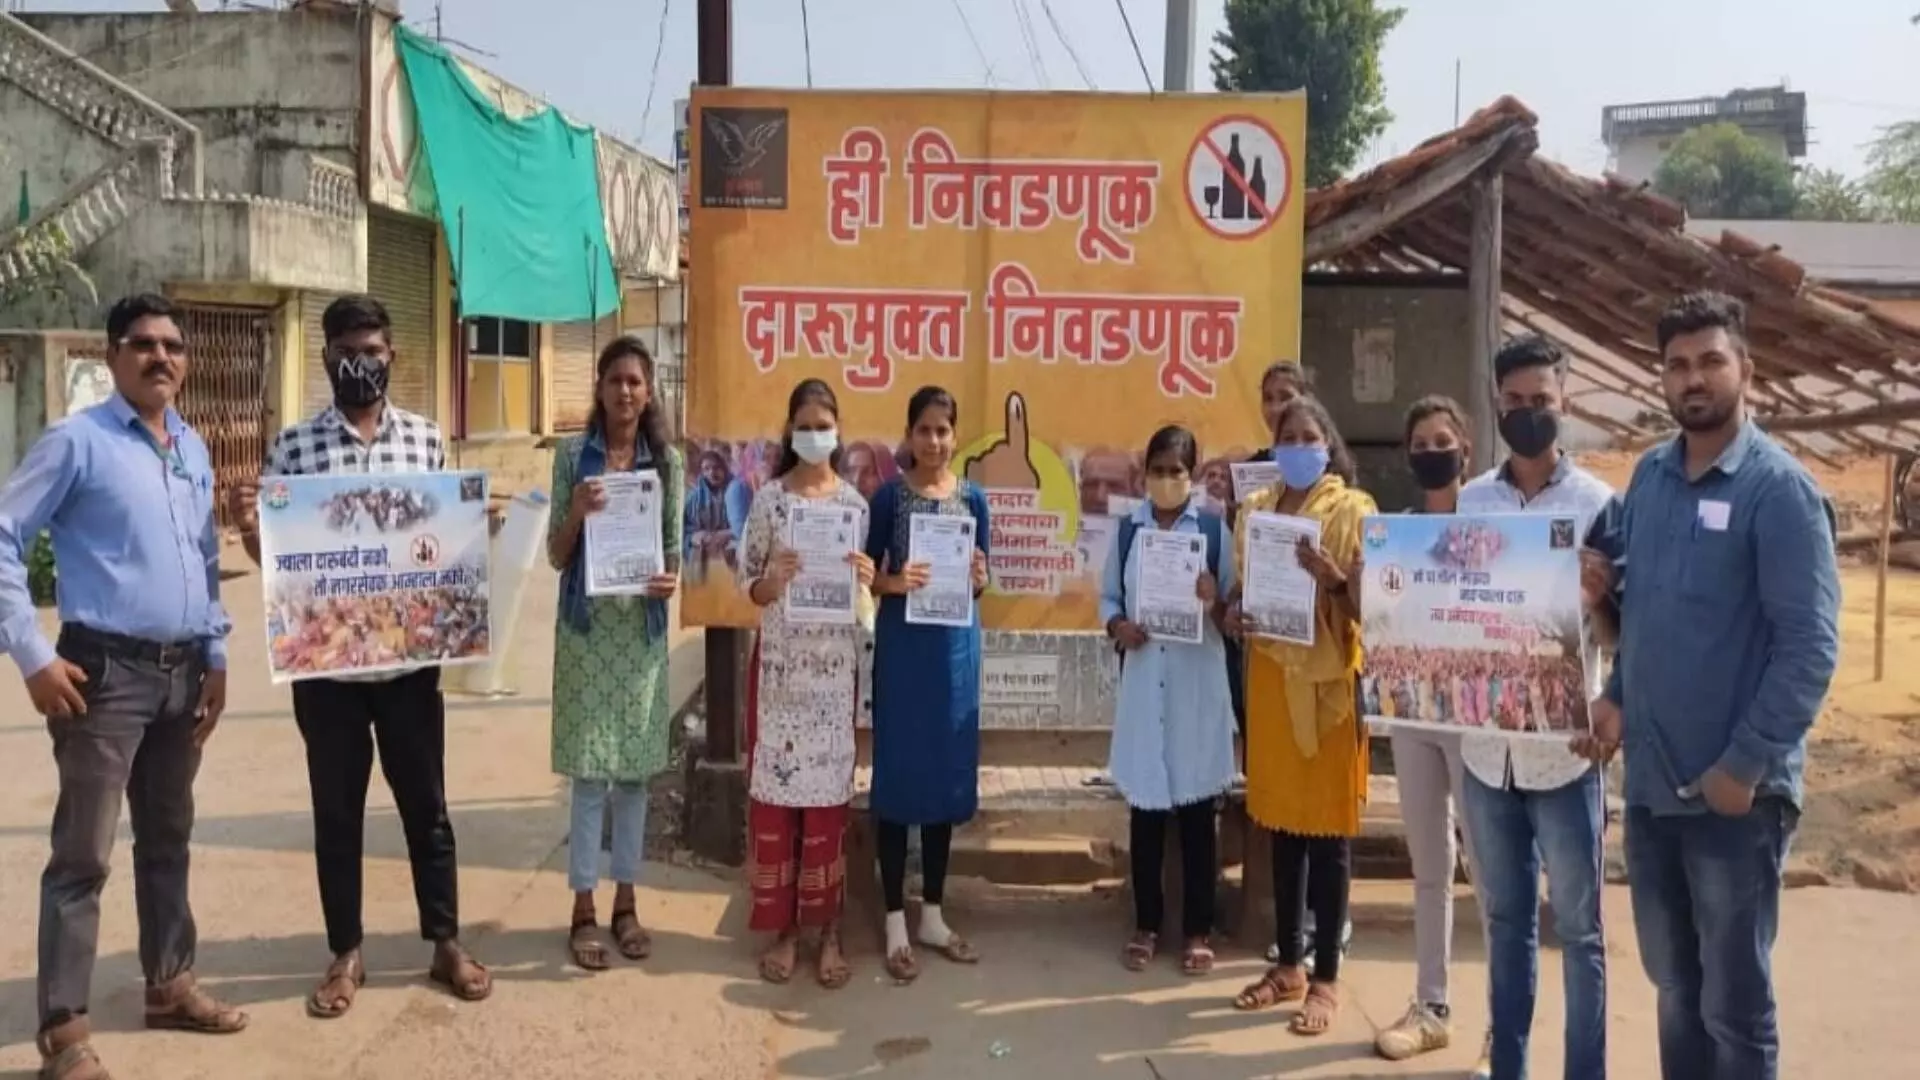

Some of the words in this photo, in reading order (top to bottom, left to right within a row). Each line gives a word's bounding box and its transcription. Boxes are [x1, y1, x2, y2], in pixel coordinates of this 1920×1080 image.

[824, 127, 888, 243] ही
[906, 128, 1159, 264] निवडणूक
[740, 286, 971, 391] दारूमुक्त
[988, 263, 1243, 397] निवडणूक
[984, 491, 1035, 509] तदार
[990, 512, 1060, 530] सल्याचा
[989, 528, 1066, 550] भिमान...
[986, 551, 1075, 573] दानासाठी
